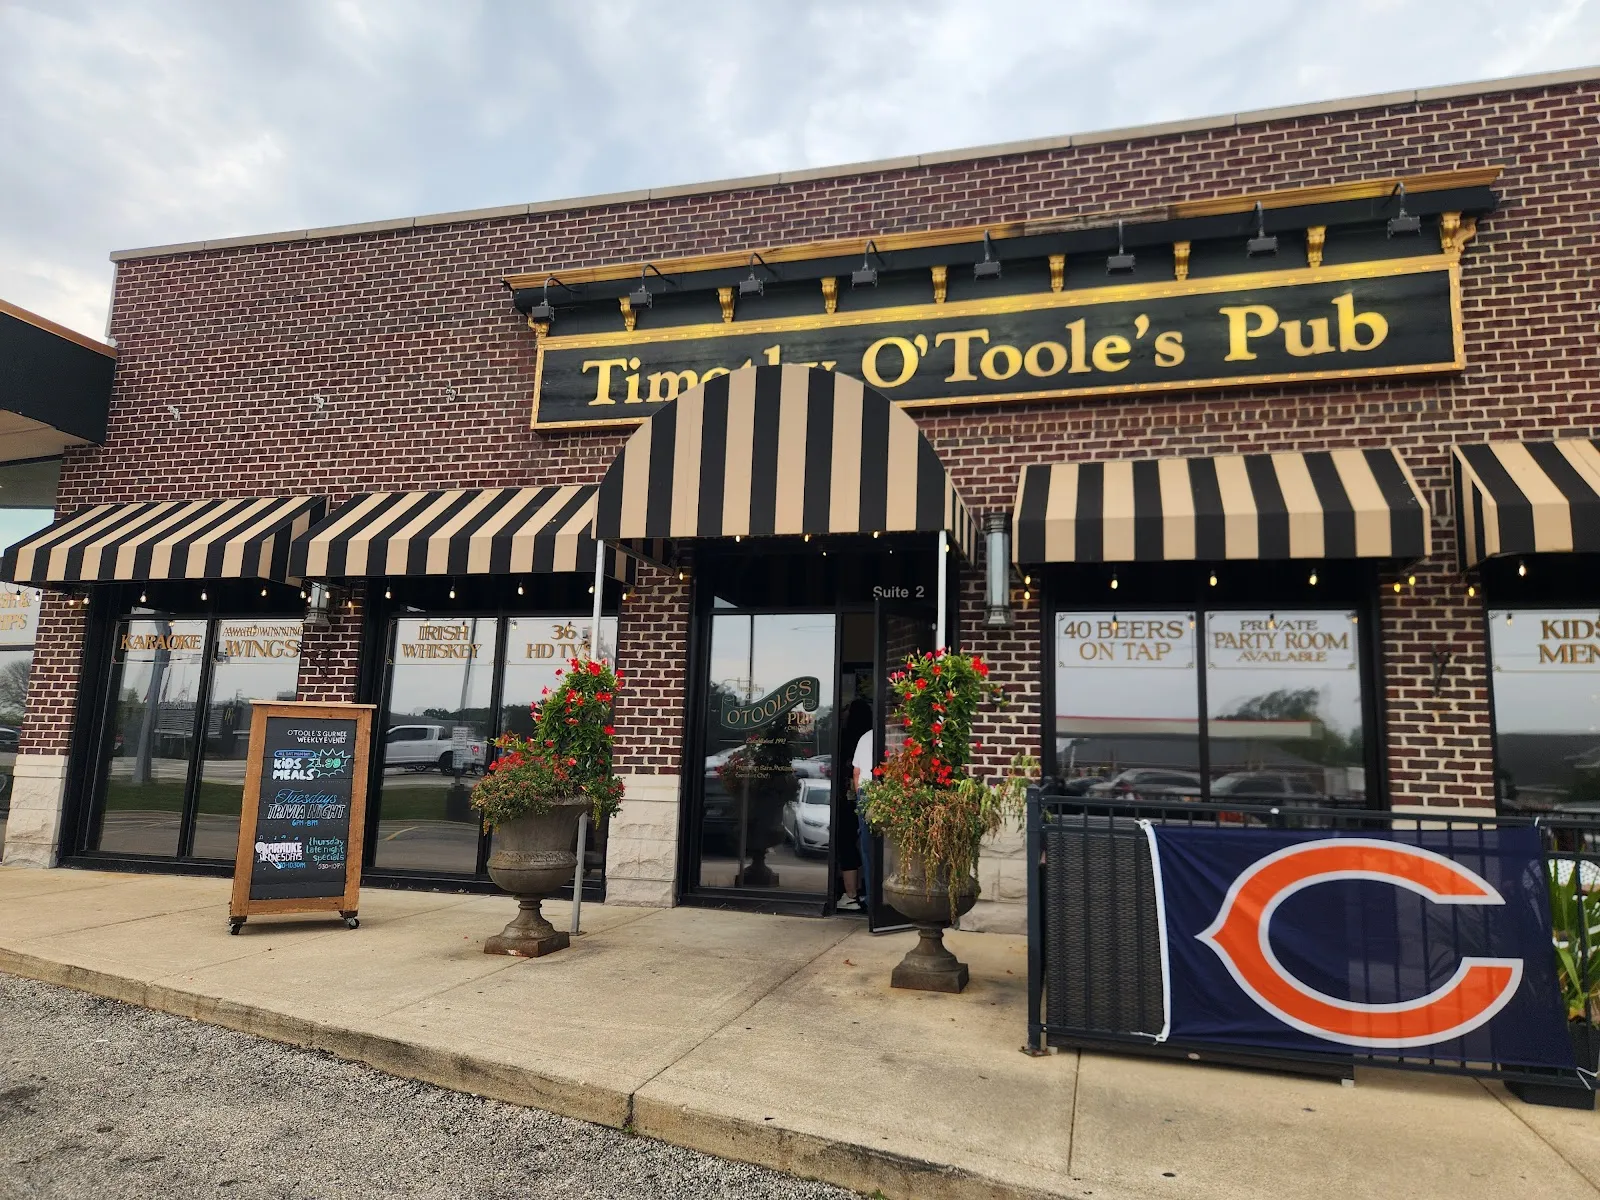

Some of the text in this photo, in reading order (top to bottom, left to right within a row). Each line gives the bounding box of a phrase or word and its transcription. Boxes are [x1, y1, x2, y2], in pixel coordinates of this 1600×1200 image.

[862, 314, 1185, 388] O'Toole's
[1219, 293, 1389, 361] Pub
[873, 586, 925, 598] Suite 2
[221, 626, 260, 638] AWARD
[418, 625, 470, 641] IRISH
[551, 624, 577, 640] 36
[1063, 620, 1184, 639] 40 BEERS
[1240, 619, 1318, 631] PRIVATE
[120, 634, 202, 651] KARAOKE
[225, 639, 300, 658] WINGS
[1214, 631, 1349, 650] PARTY ROOM
[402, 643, 482, 659] WHISKEY
[526, 643, 556, 659] HD
[1079, 642, 1173, 660] ON TAP
[1238, 651, 1328, 662] AVAILABLE
[727, 680, 812, 725] O'TOOLE'S
[272, 769, 315, 780] MEALS
[275, 788, 338, 808] Tuesdays
[267, 804, 346, 819] TRIVIA NIGHT
